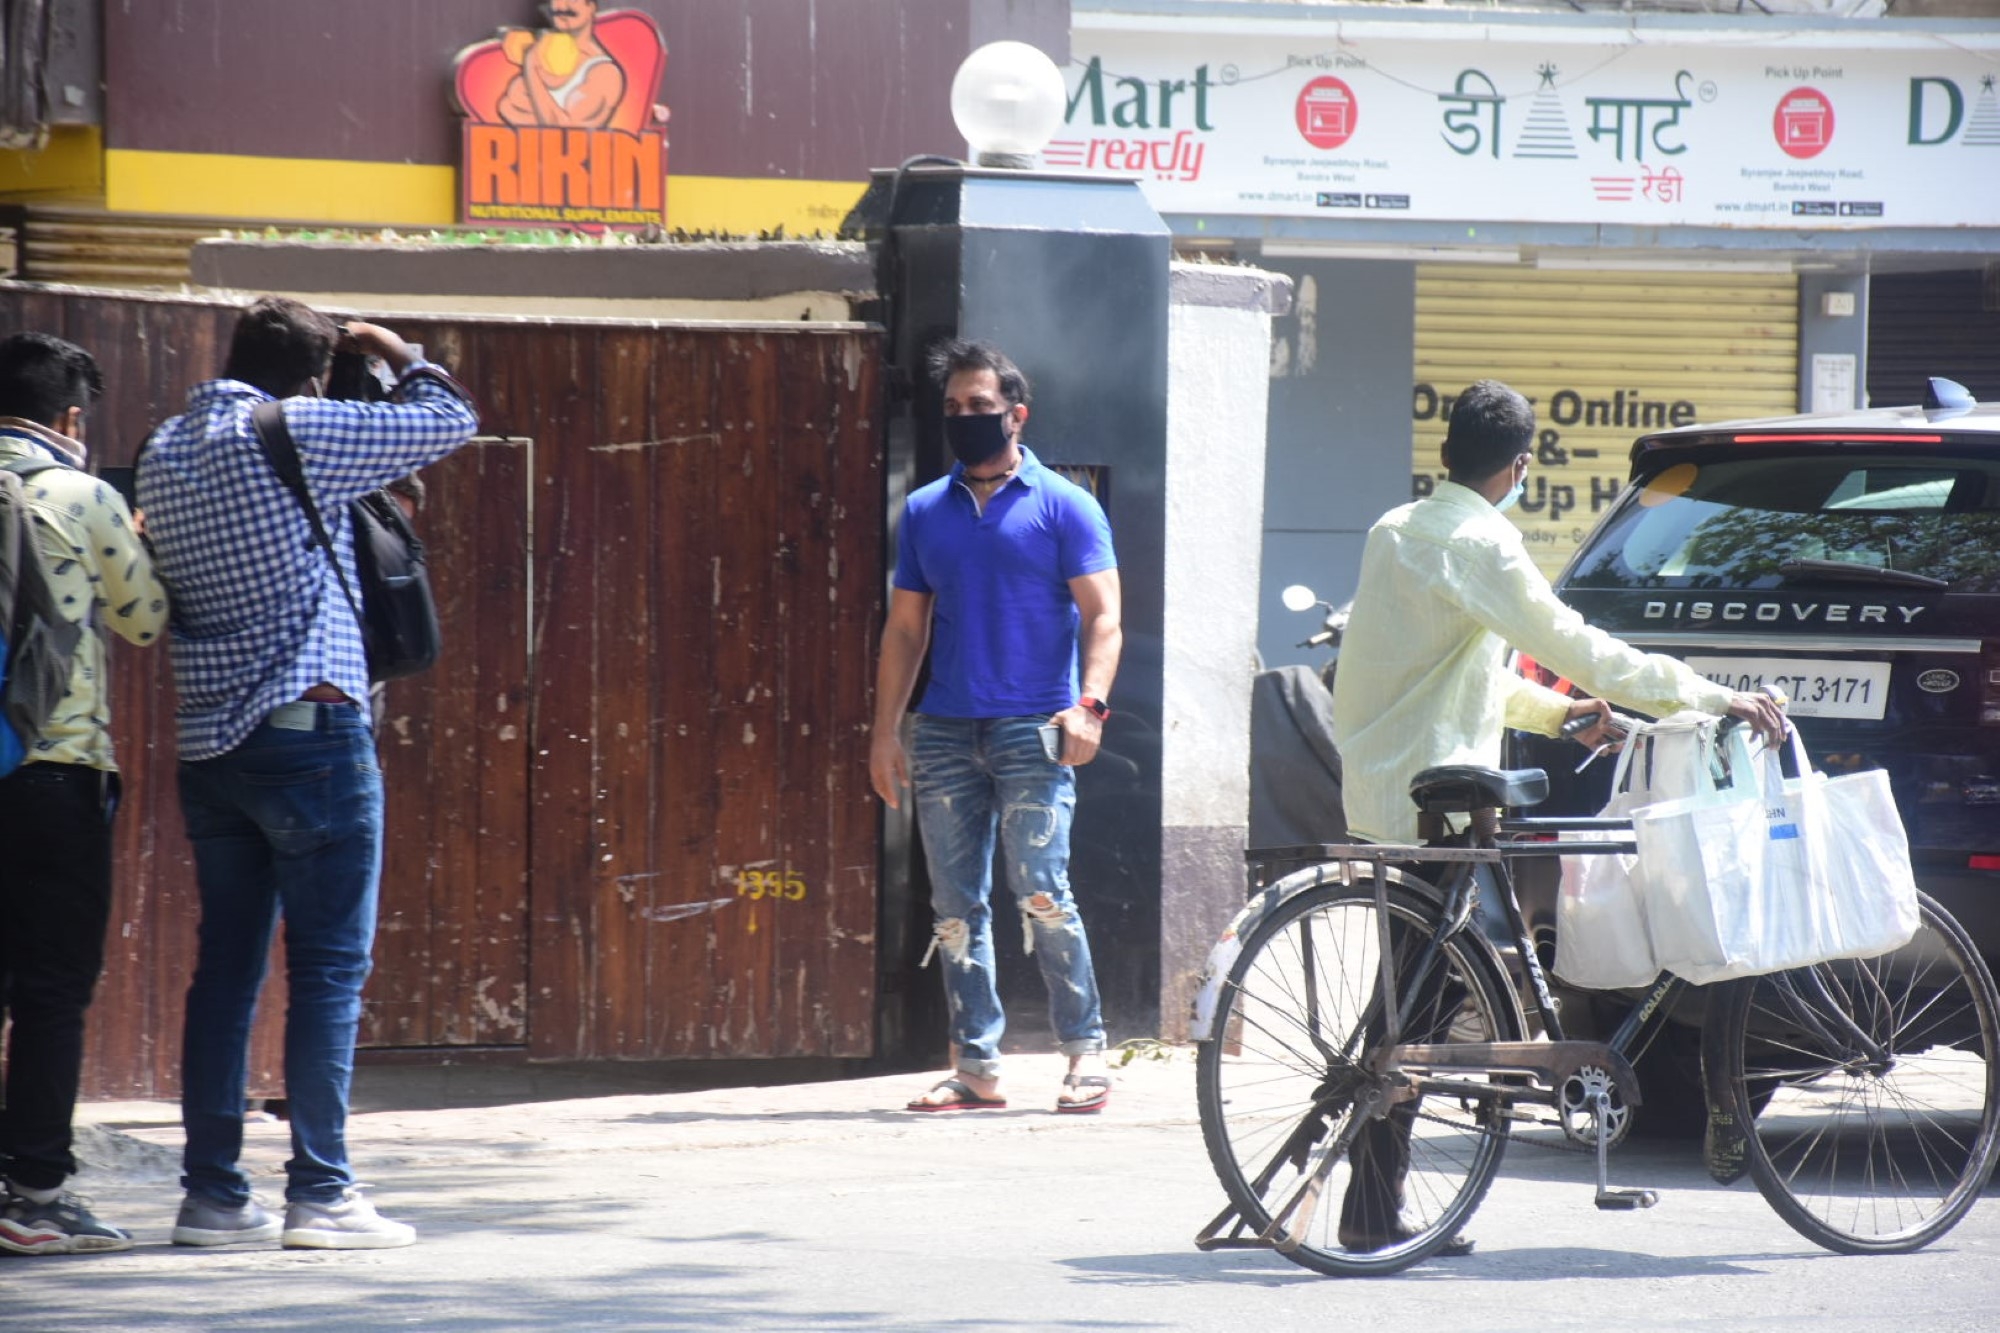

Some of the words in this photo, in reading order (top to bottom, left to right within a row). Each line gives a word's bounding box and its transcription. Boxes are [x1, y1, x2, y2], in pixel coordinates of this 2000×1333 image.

[1765, 66, 1790, 78] Pick
[1793, 67, 1810, 80] Up
[1813, 67, 1843, 79] Point
[1437, 69, 1506, 160] डी
[1585, 69, 1693, 162] मार्ट
[1907, 76, 1964, 145] D
[469, 125, 661, 211] RIKIN
[1086, 131, 1206, 181] ready
[1641, 164, 1684, 203] रेडी
[1551, 390, 1697, 427] Online
[1537, 429, 1570, 466] &
[1518, 475, 1575, 521] Up
[1643, 601, 1926, 623] DISCOVERY
